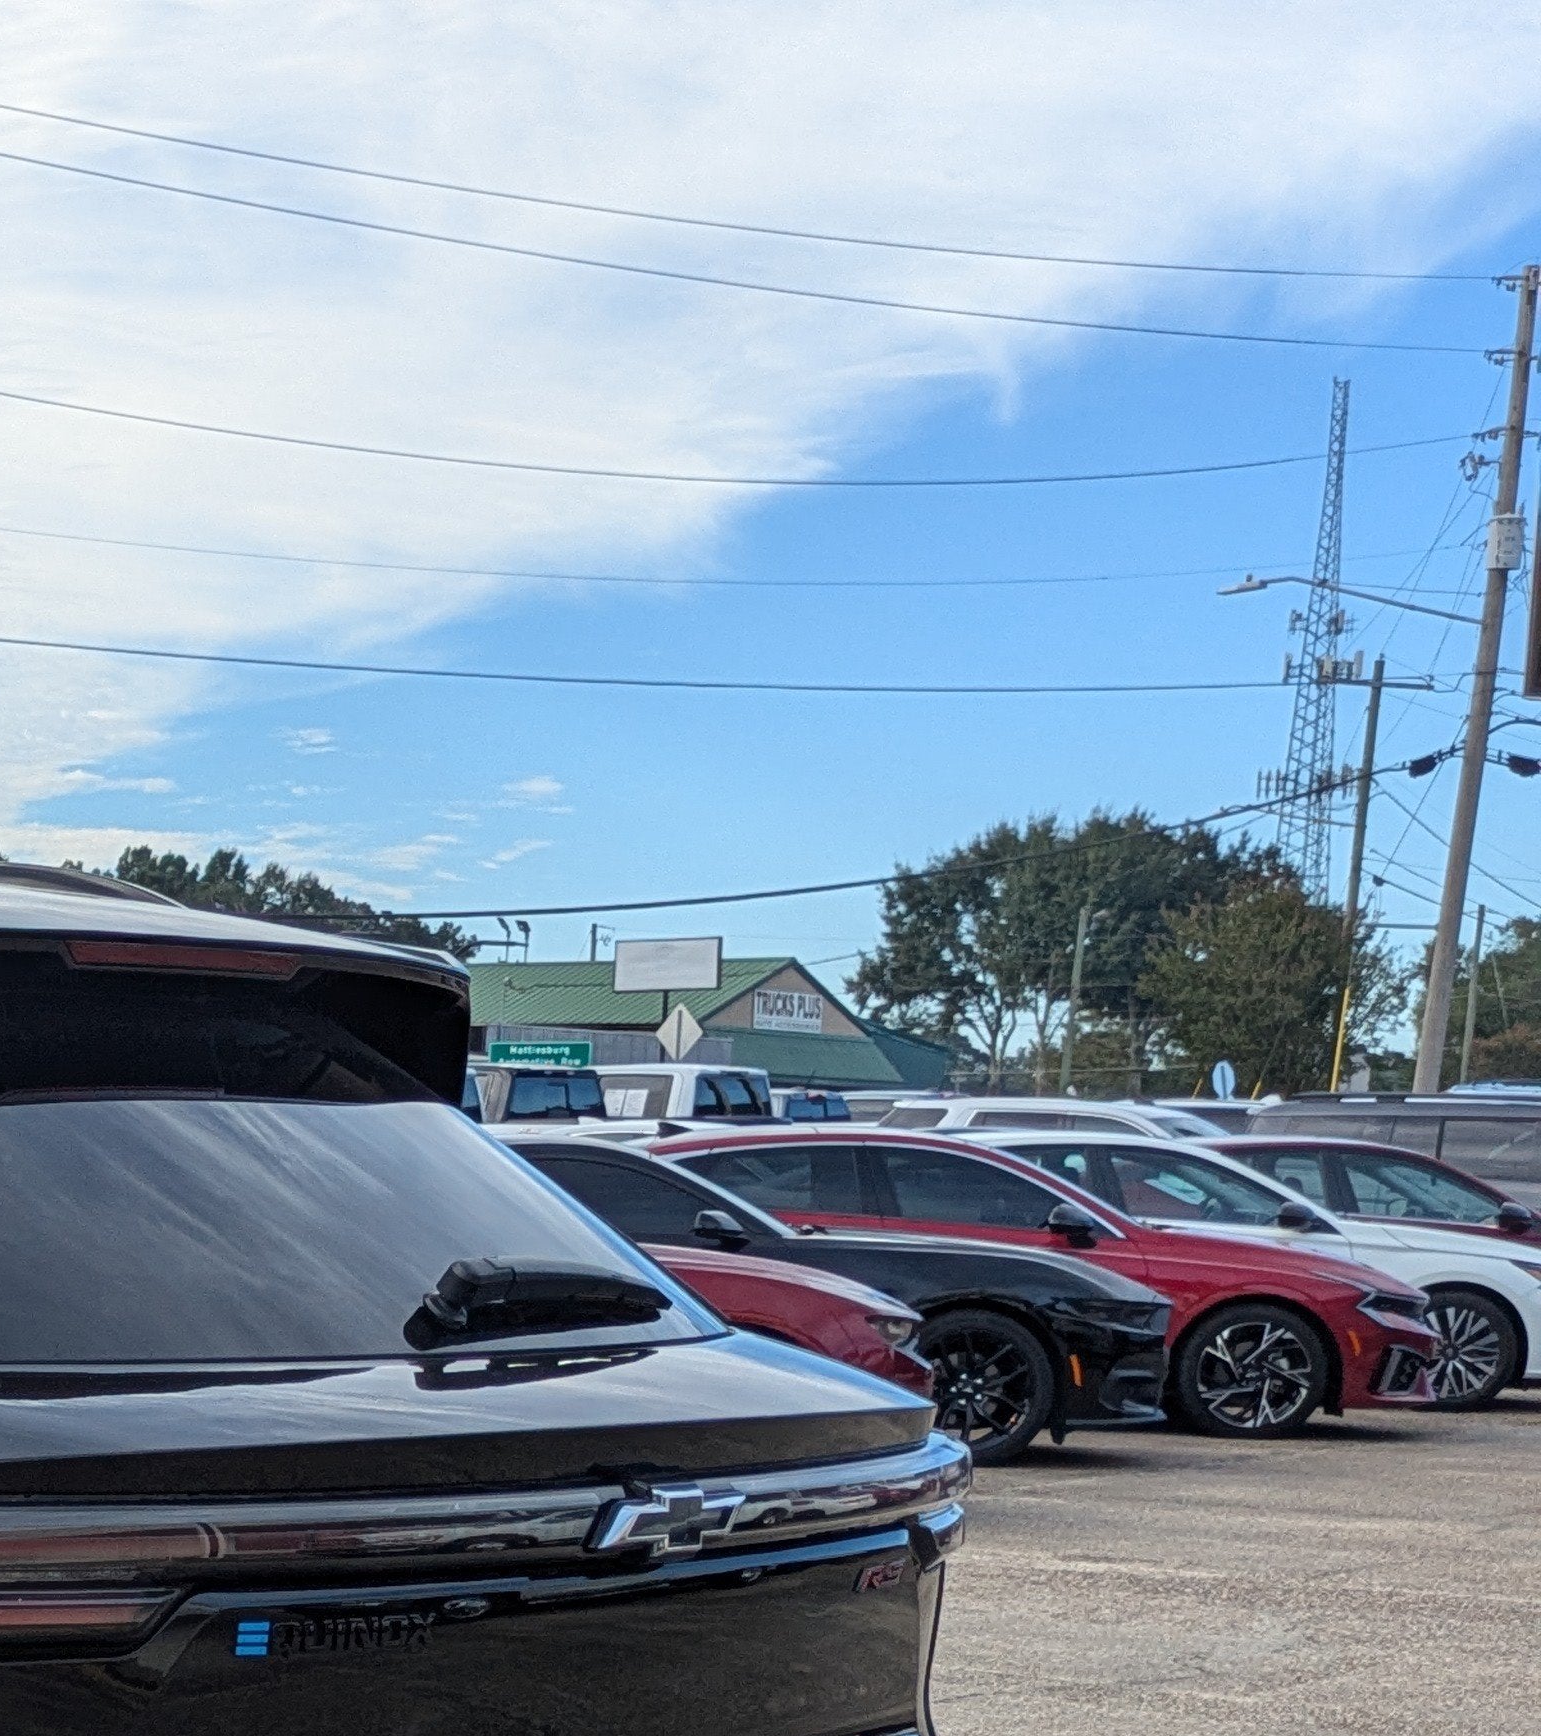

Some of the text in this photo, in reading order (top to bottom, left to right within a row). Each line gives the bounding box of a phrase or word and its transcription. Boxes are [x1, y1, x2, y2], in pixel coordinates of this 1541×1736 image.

[756, 991, 821, 1019] TRUCKS PLUS
[509, 1045, 570, 1056] Hattiesburg
